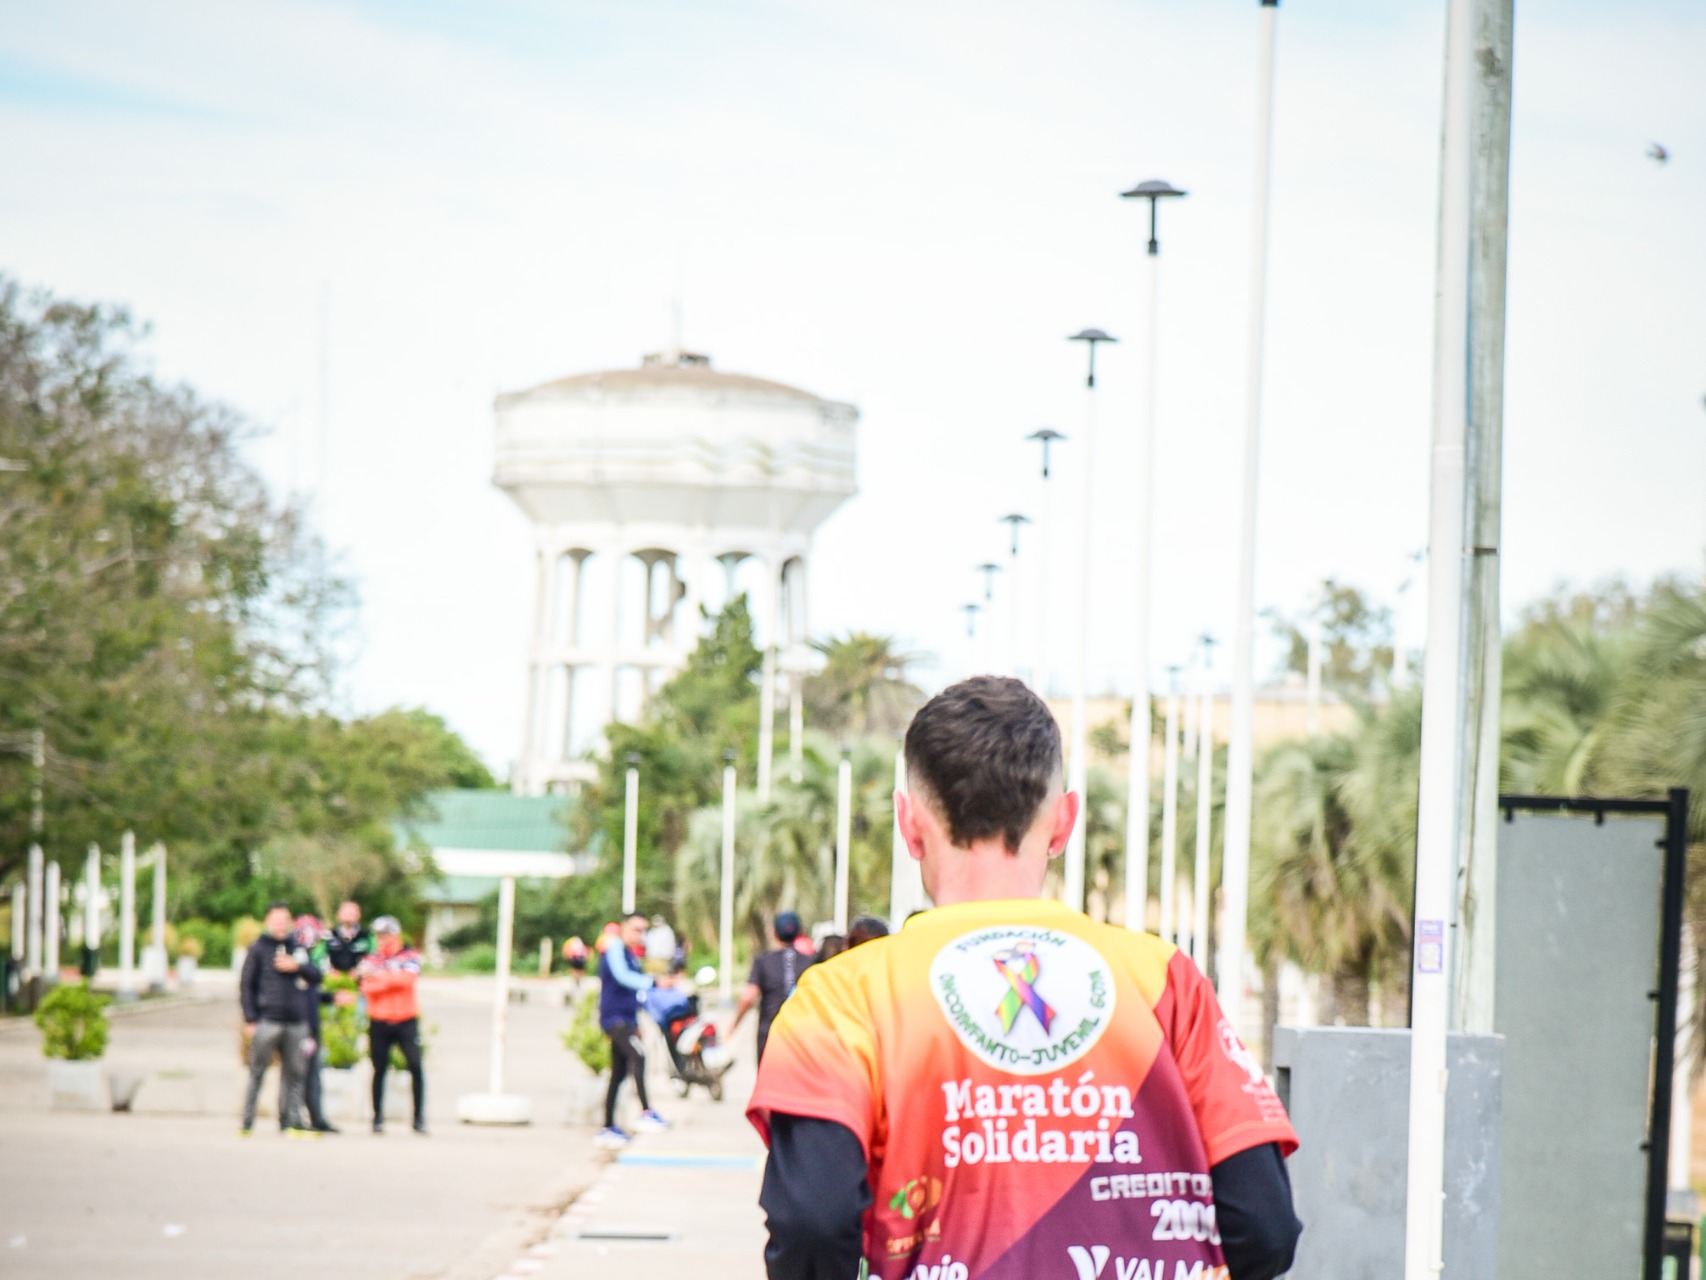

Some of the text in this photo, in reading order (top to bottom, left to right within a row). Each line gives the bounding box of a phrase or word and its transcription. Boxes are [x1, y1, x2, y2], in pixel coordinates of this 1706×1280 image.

[941, 1069, 1135, 1123] Maratón
[942, 1117, 1143, 1169] Solidaria
[1090, 1171, 1214, 1202] CREDITO
